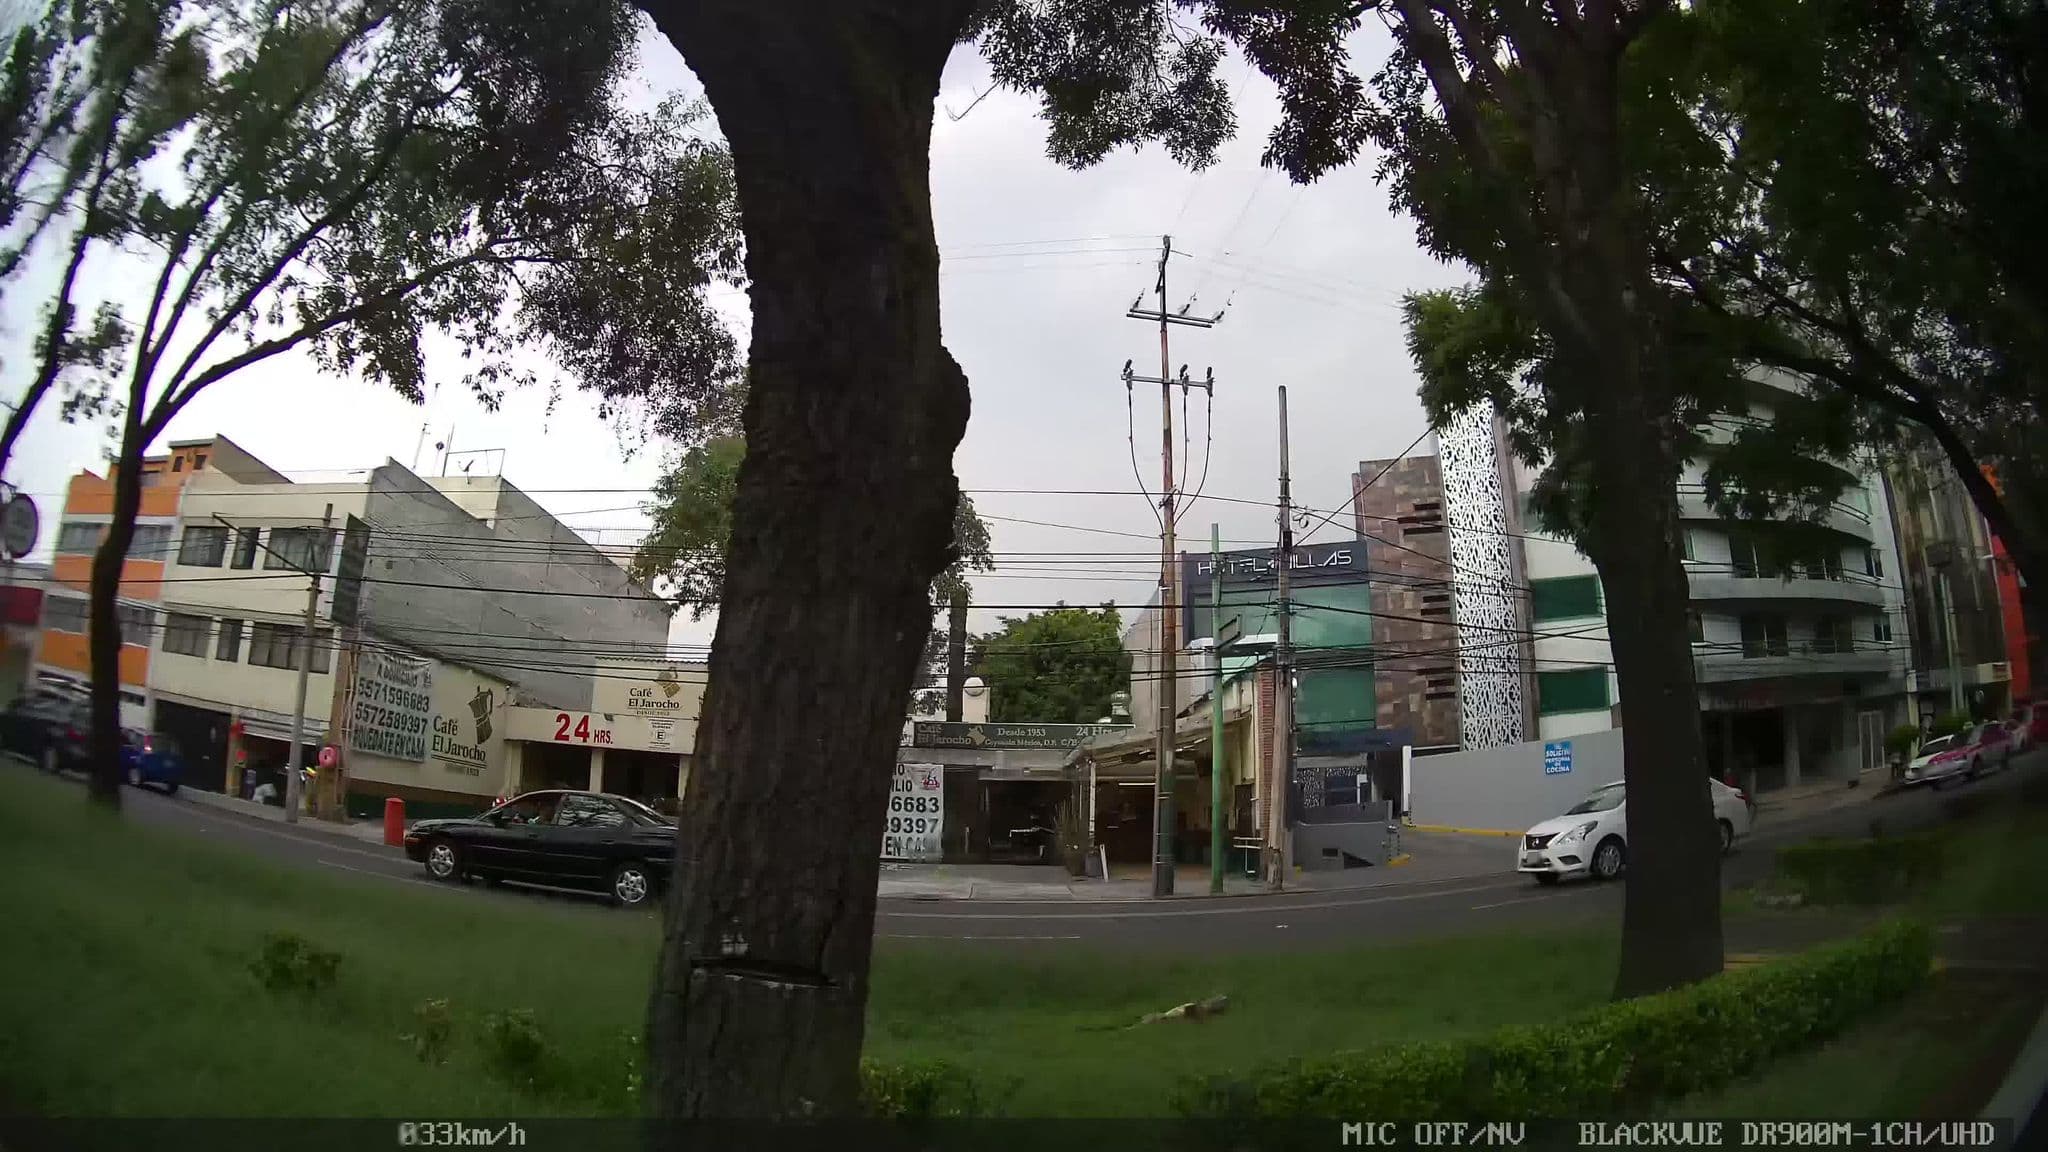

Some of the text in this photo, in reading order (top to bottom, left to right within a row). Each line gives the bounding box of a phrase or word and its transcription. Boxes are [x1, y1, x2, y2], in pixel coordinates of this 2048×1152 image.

[1198, 557, 1268, 575] HTEL
[358, 677, 430, 713] 5571596683
[630, 687, 652, 697] Café
[629, 699, 680, 709] El Jarocho
[355, 702, 428, 735] 5572589397
[434, 716, 458, 736] Café
[554, 713, 613, 745] 24 HRS.
[998, 728, 1046, 737] Desde 1953
[1076, 727, 1089, 736] 24
[433, 735, 486, 762] El Jarocho
[930, 734, 972, 745] Jarocho
[886, 836, 902, 856] EN
